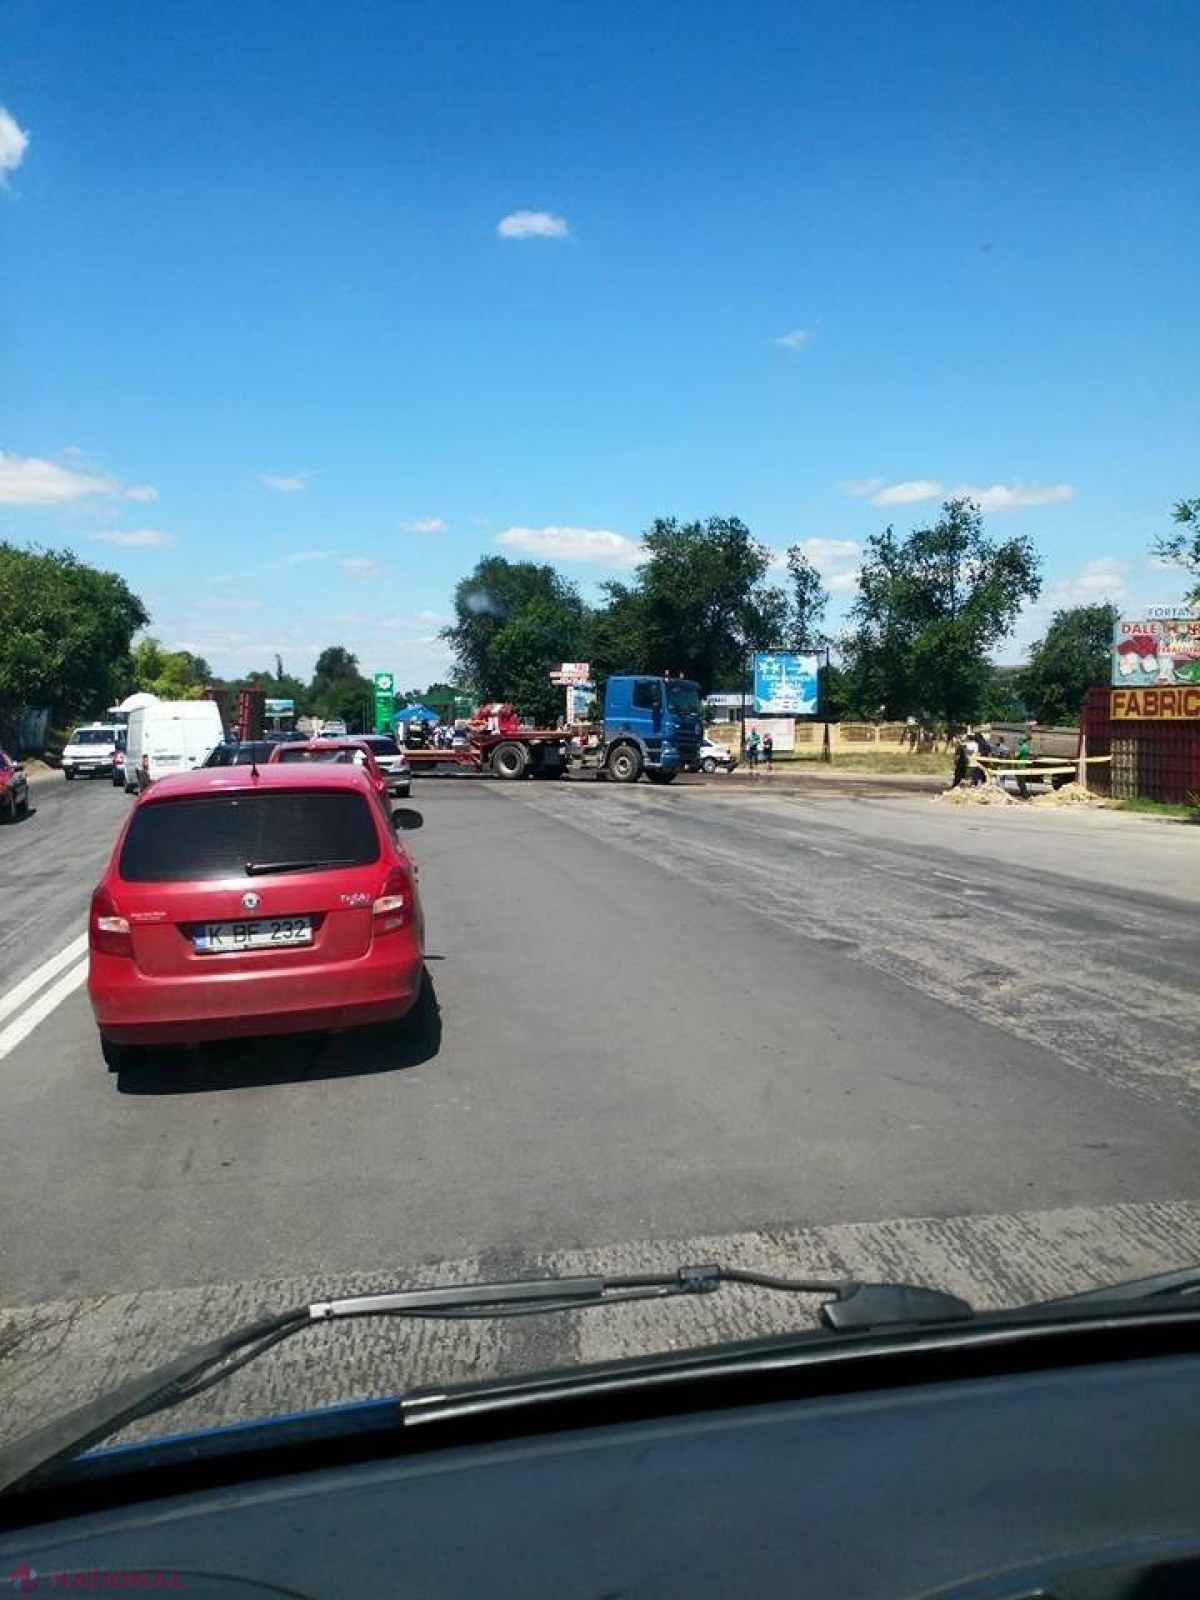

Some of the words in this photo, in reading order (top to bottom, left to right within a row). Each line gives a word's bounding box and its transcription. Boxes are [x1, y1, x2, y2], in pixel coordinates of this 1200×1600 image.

[1121, 623, 1158, 635] DALE
[209, 926, 223, 946] K
[232, 922, 260, 943] BF
[270, 918, 306, 941] 232
